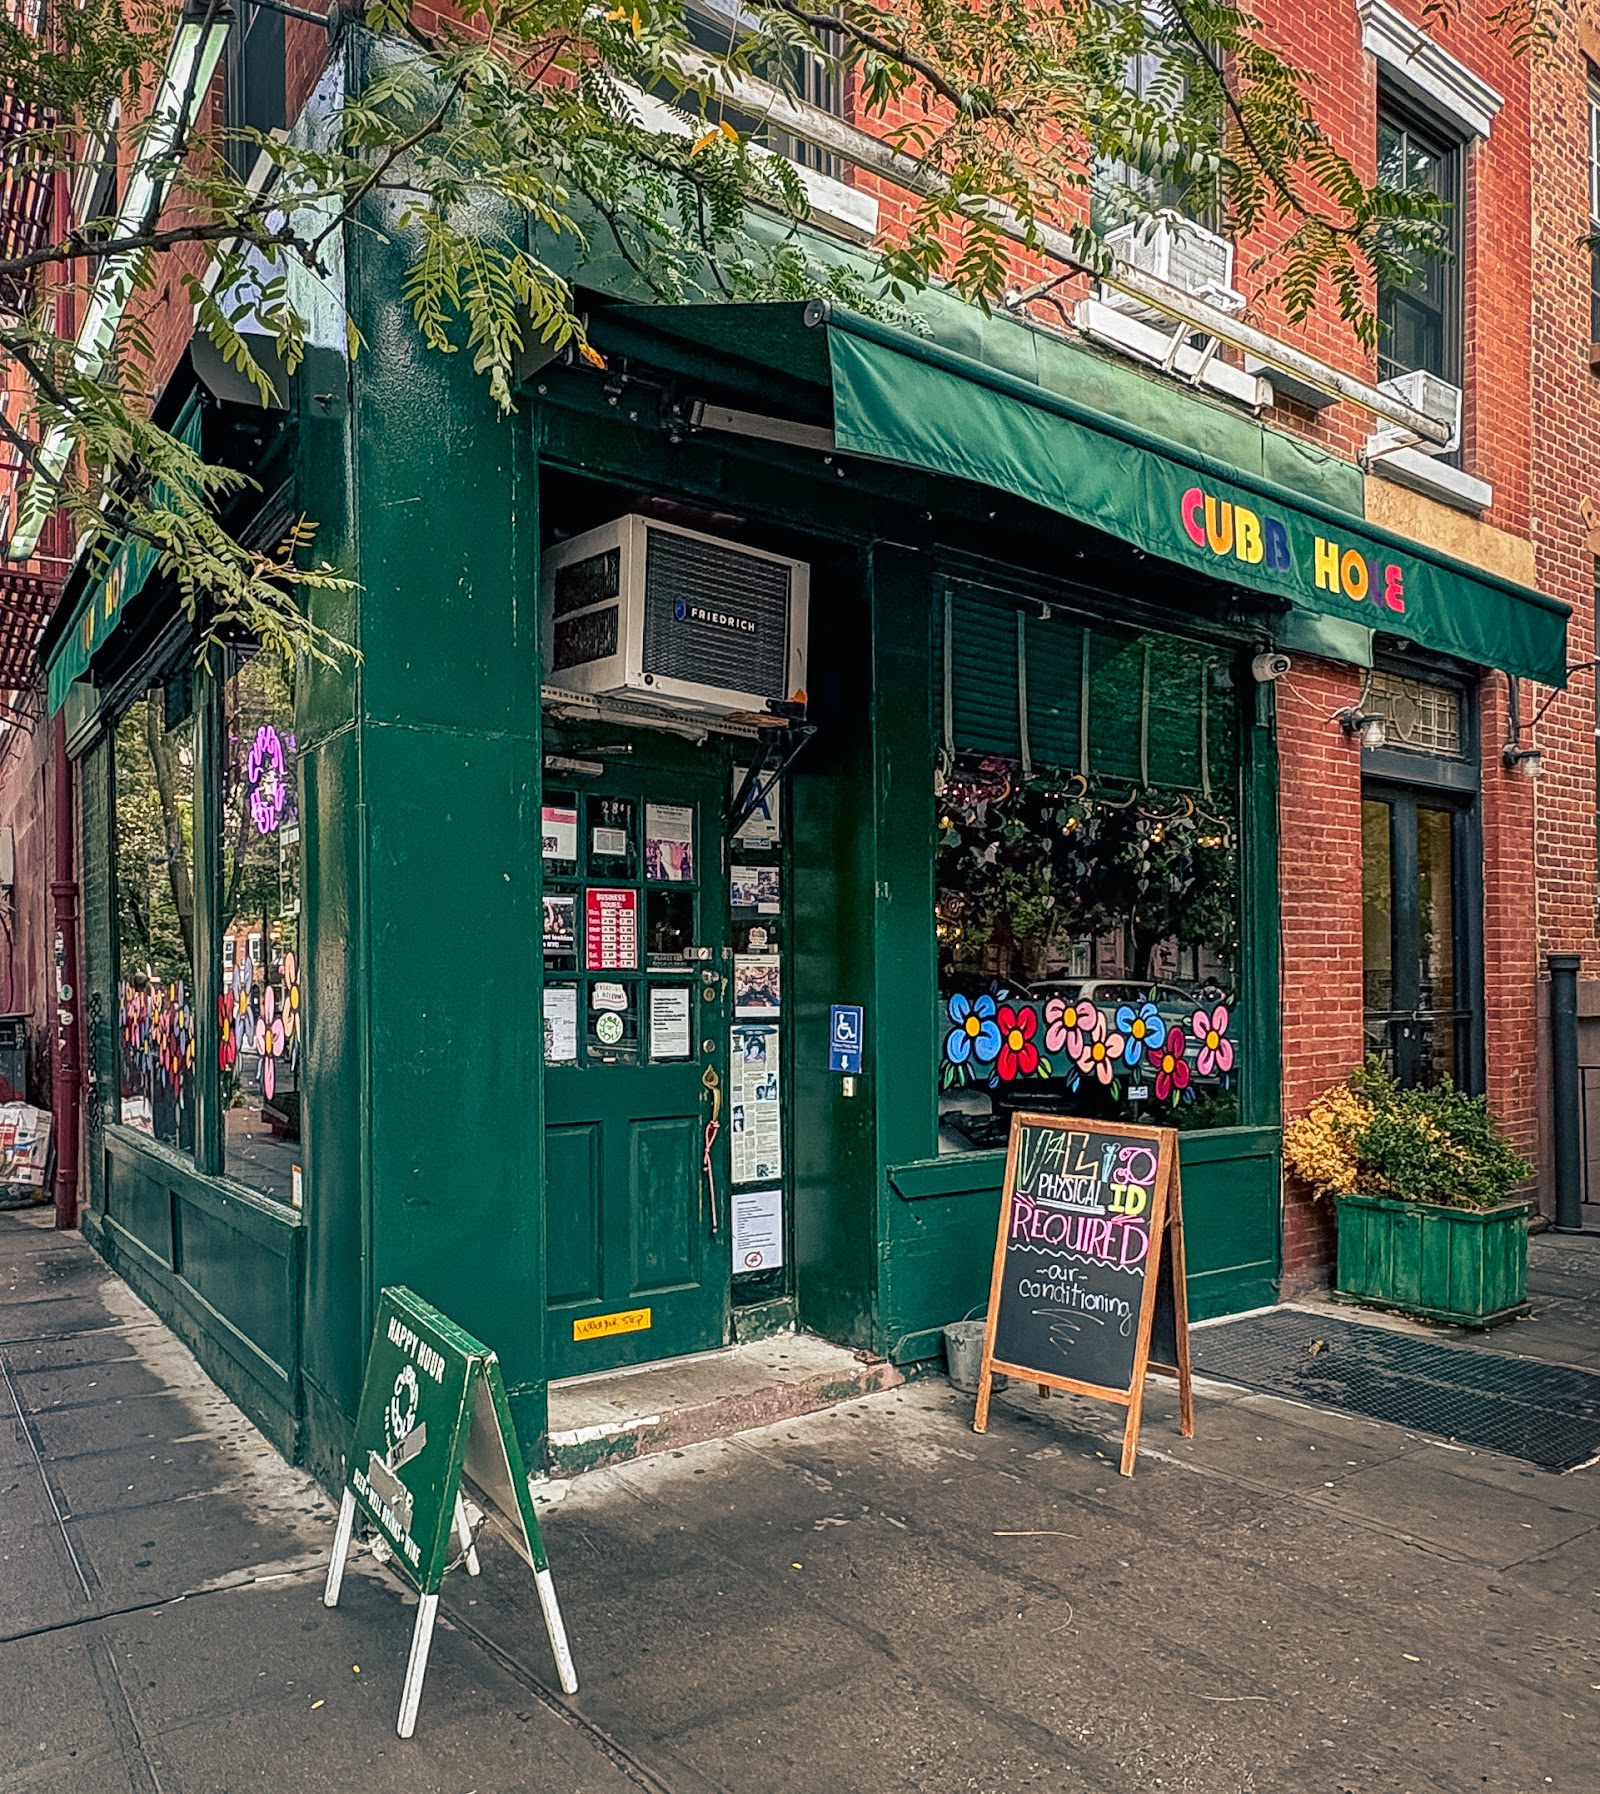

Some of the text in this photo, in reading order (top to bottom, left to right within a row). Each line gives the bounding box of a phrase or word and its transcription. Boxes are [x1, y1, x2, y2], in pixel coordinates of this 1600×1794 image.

[1181, 487, 1405, 613] CUBB HOLE
[691, 607, 755, 632] FRIEDRICH
[1038, 1172, 1147, 1216] PHYSICAL ID
[1011, 1202, 1149, 1266] REQUIRED
[1018, 1278, 1133, 1337] conditioning
[387, 1316, 445, 1385] HAPPY HOUR
